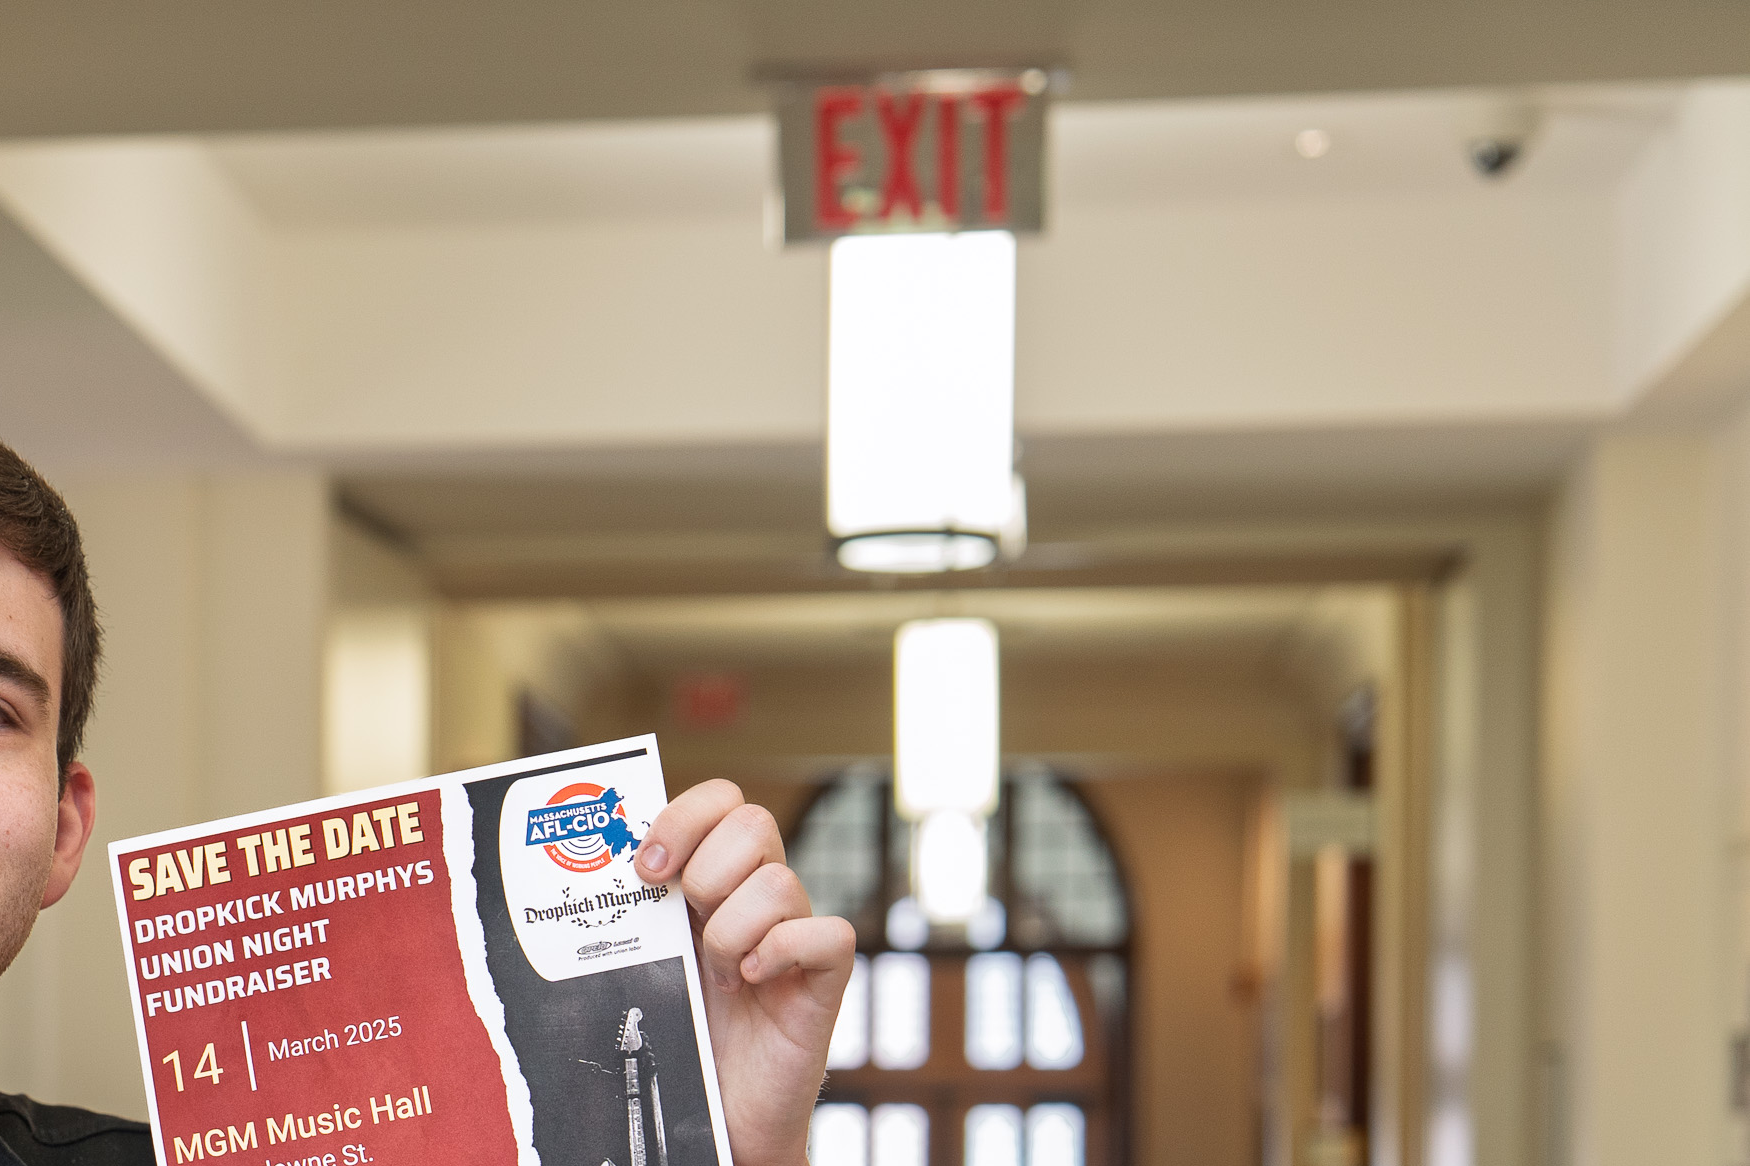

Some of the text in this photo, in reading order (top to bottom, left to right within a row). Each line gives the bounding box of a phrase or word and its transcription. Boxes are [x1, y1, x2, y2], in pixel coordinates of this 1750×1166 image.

[815, 84, 1025, 230] EXIT
[529, 802, 607, 825] MASSACHUSETTS
[530, 812, 611, 842] AFL-CIO
[129, 802, 424, 901] SAVE THE DATE
[134, 860, 435, 944] DROPKICK MURPHYS
[524, 884, 669, 924] Dropkick Murphys
[140, 919, 329, 980] UNION NIGHT
[146, 957, 332, 1017] FUNDRAISER
[162, 1016, 402, 1092] 14 March 2025
[173, 1085, 432, 1164] MGM Music Hall
[342, 1144, 373, 1166] St.
